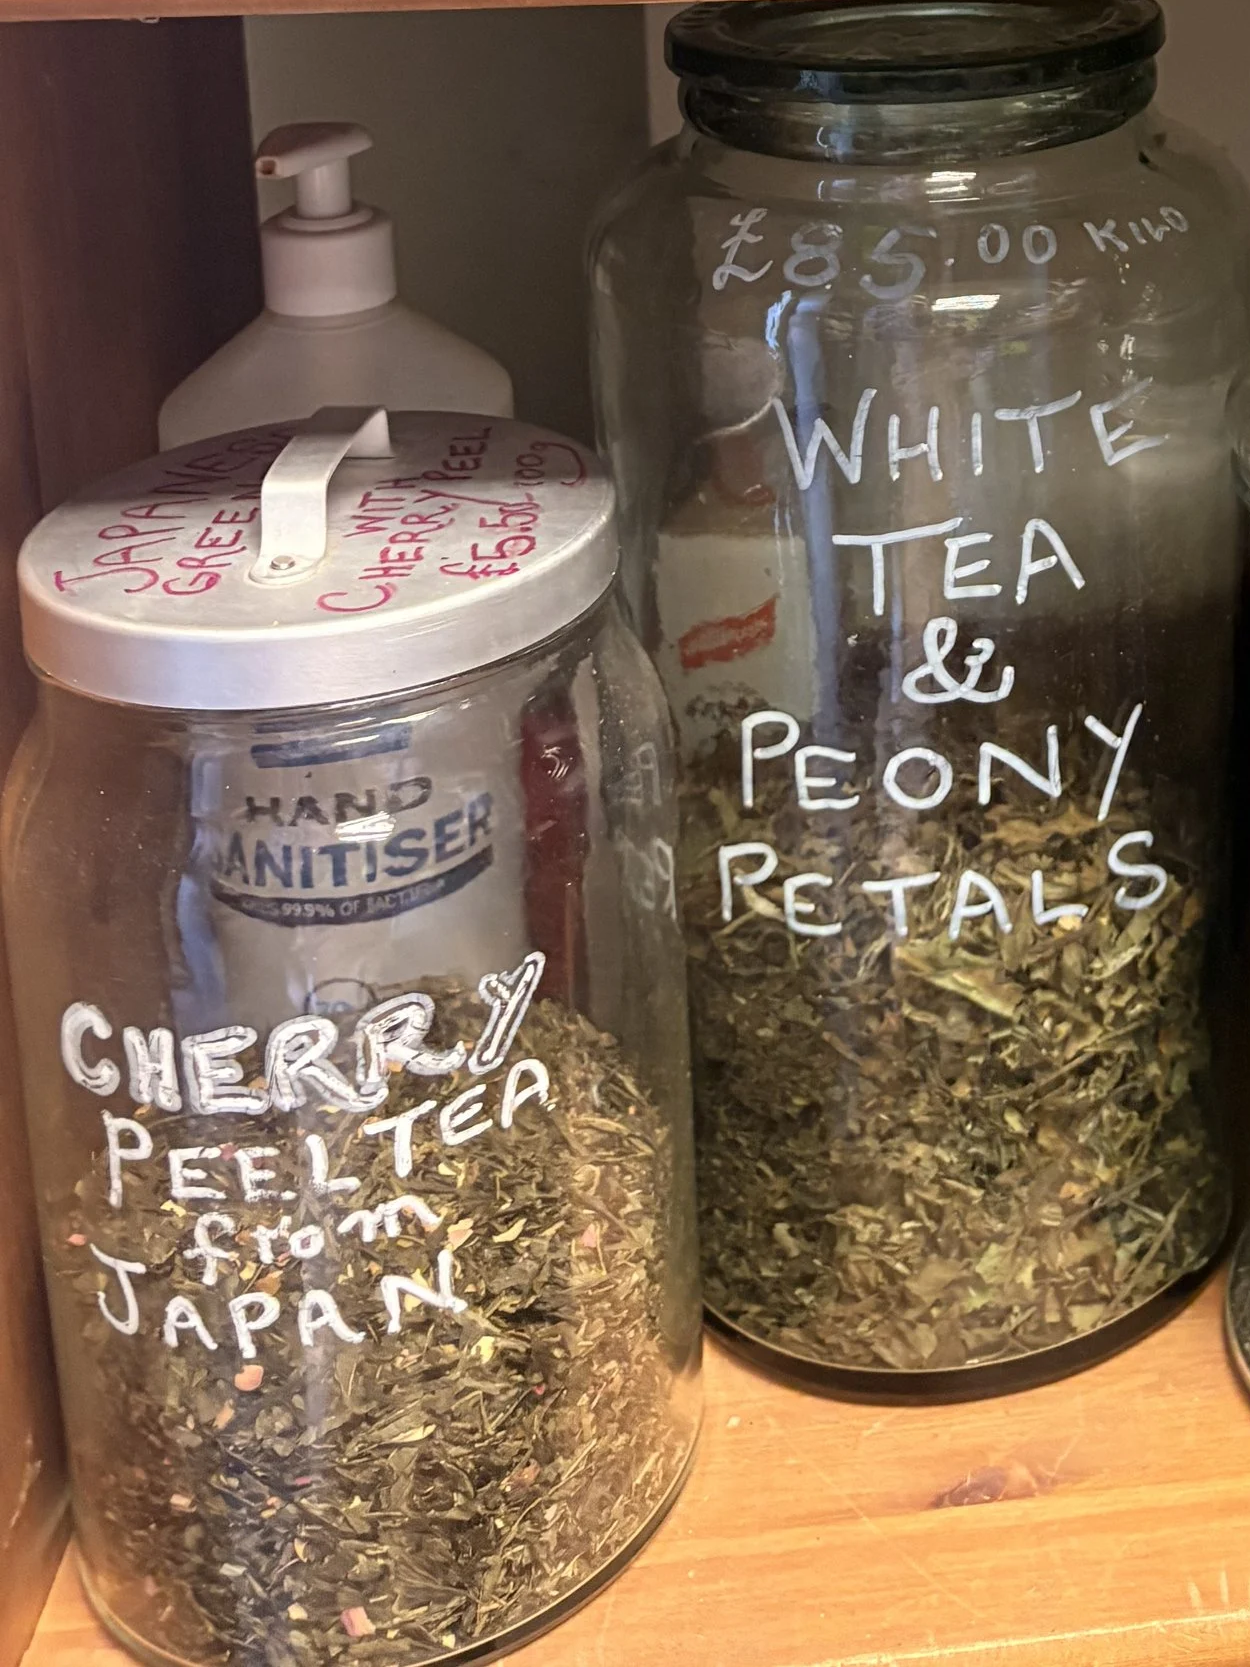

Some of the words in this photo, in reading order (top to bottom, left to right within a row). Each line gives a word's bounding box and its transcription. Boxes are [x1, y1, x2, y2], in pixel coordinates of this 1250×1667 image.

[712, 207, 1058, 300] £85.00
[421, 426, 493, 484] PEEL
[771, 376, 1171, 491] WHITE
[342, 474, 426, 538] WITH
[832, 517, 1086, 616] TEA
[902, 616, 1015, 705] &
[245, 775, 433, 826] HAND
[740, 702, 1145, 821] PEONY
[717, 829, 1169, 940] PETALS
[59, 950, 547, 1116] CHERRY
[101, 1110, 362, 1209] PEEL
[363, 1058, 557, 1178] TEA
[182, 1194, 443, 1286] from
[89, 1242, 468, 1359] JAPAN
